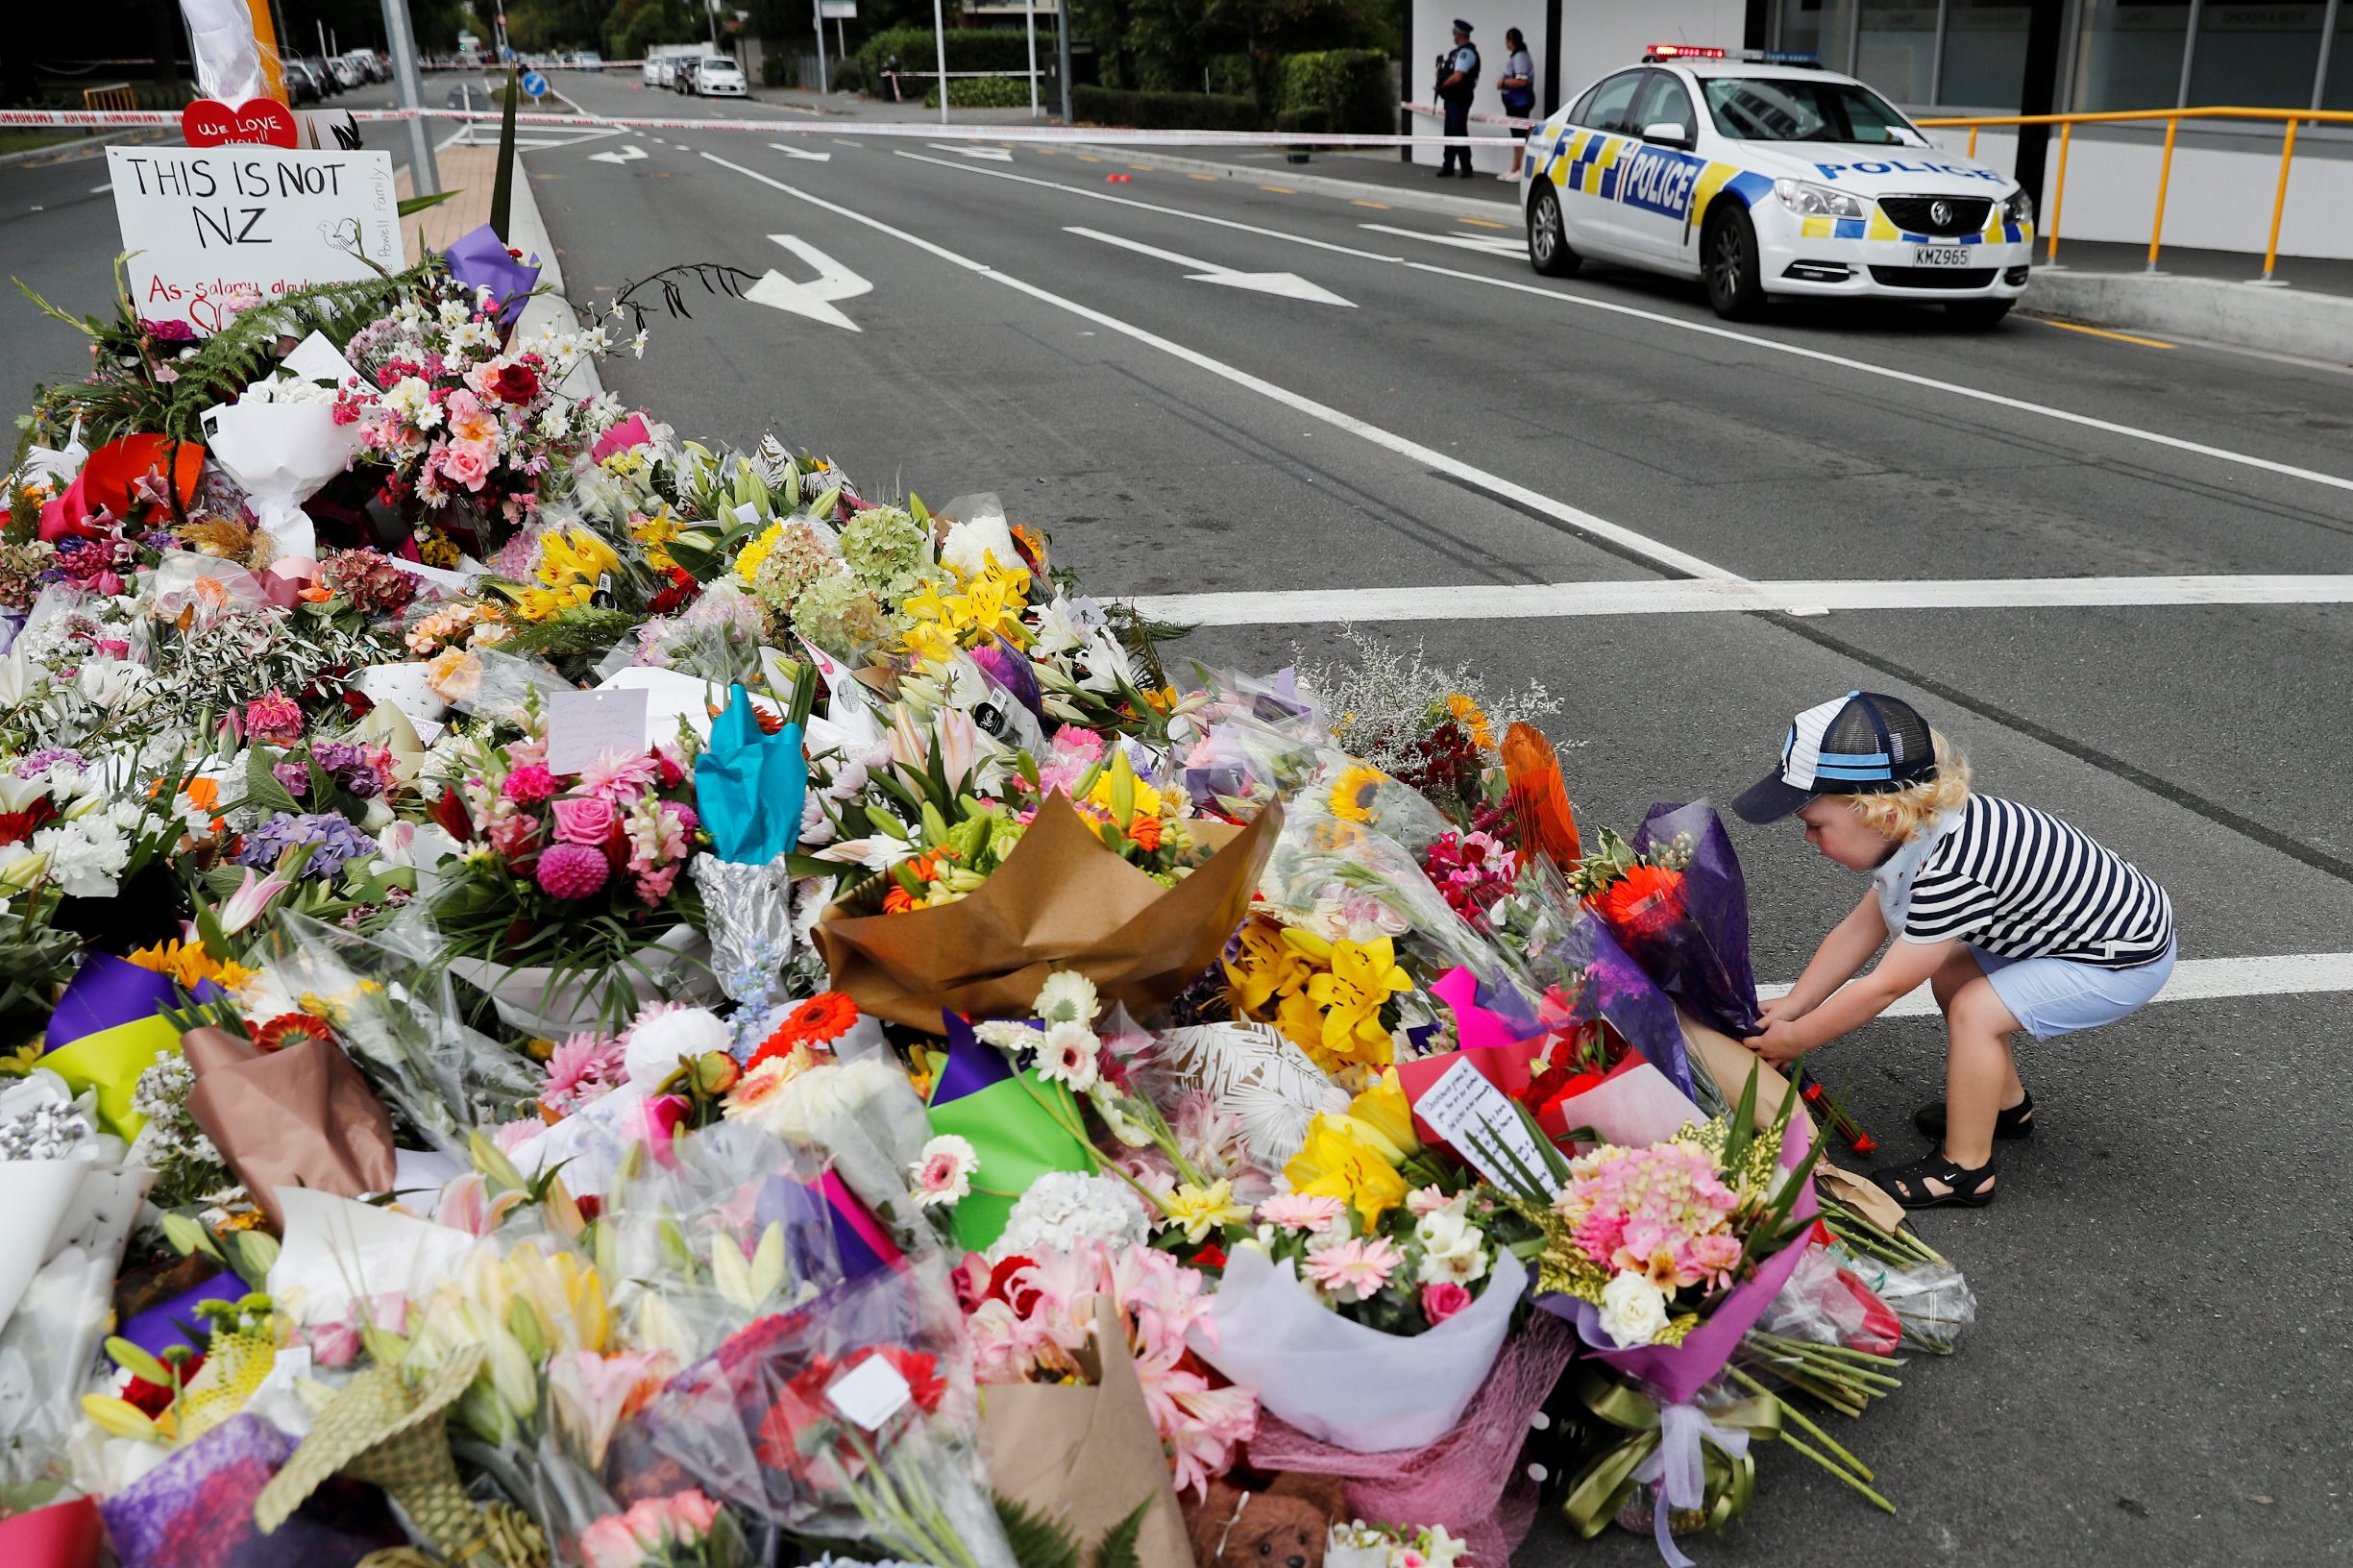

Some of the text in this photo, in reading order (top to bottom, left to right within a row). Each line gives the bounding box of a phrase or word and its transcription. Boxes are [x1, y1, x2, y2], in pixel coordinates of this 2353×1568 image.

[235, 115, 282, 133] LOVE
[127, 159, 345, 198] THIS IS NOT
[368, 167, 390, 211] Family
[1627, 152, 1699, 211] POLICE
[1813, 160, 2008, 186] POLICE
[1916, 246, 1969, 265] KMZ965
